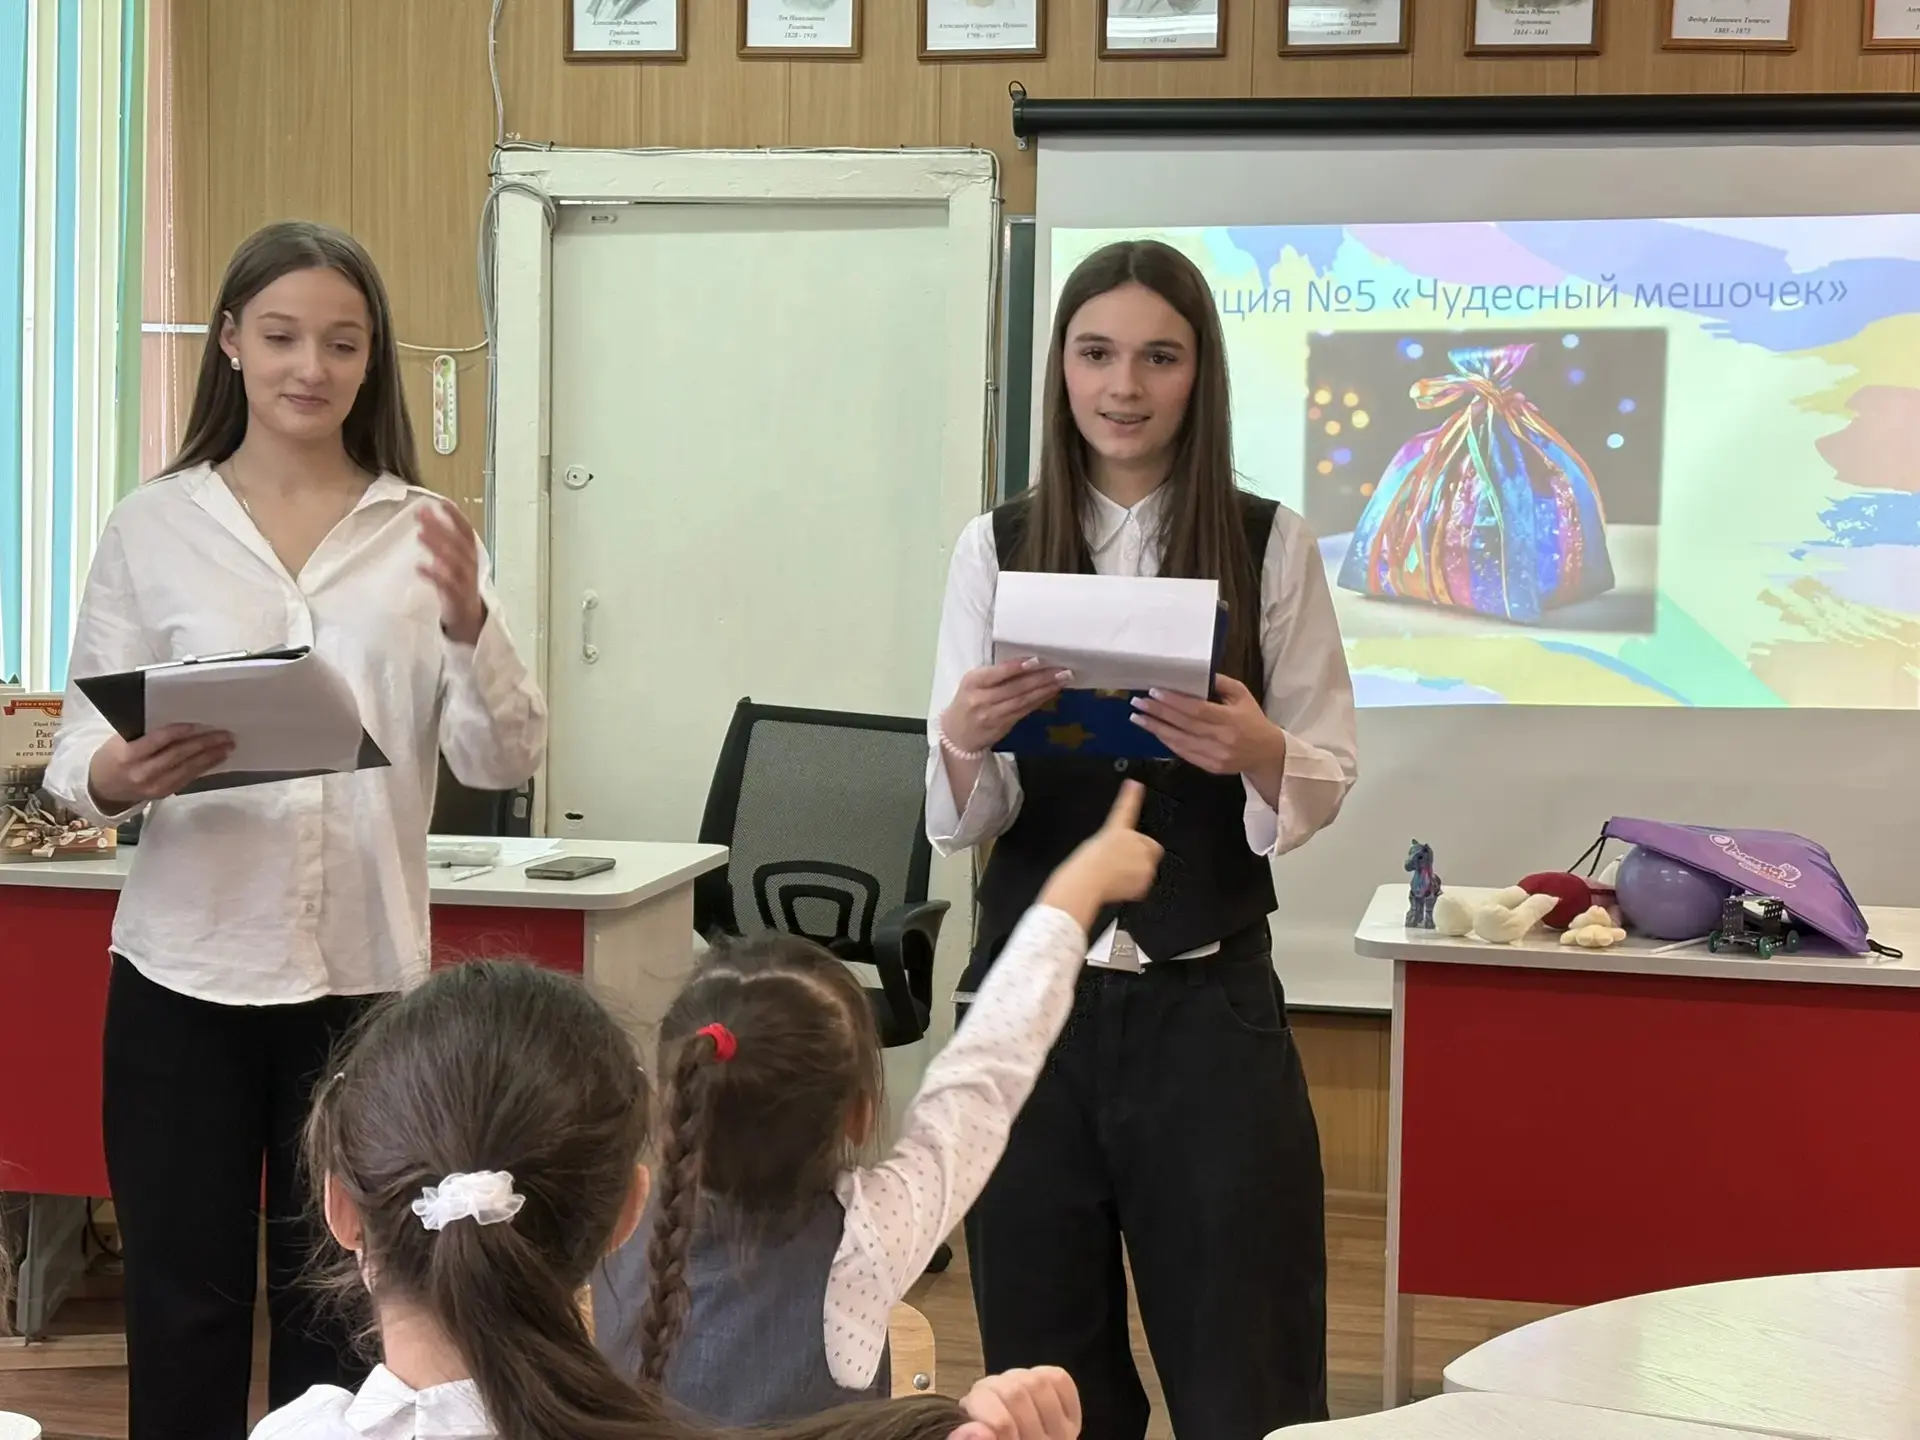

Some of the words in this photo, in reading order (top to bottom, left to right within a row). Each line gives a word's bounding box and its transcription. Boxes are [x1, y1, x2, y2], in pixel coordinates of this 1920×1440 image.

[1212, 288, 1291, 321] ция
[1307, 279, 1377, 313] №5
[1392, 273, 1619, 320] «Чудесный
[1633, 279, 1848, 308] мешочек»
